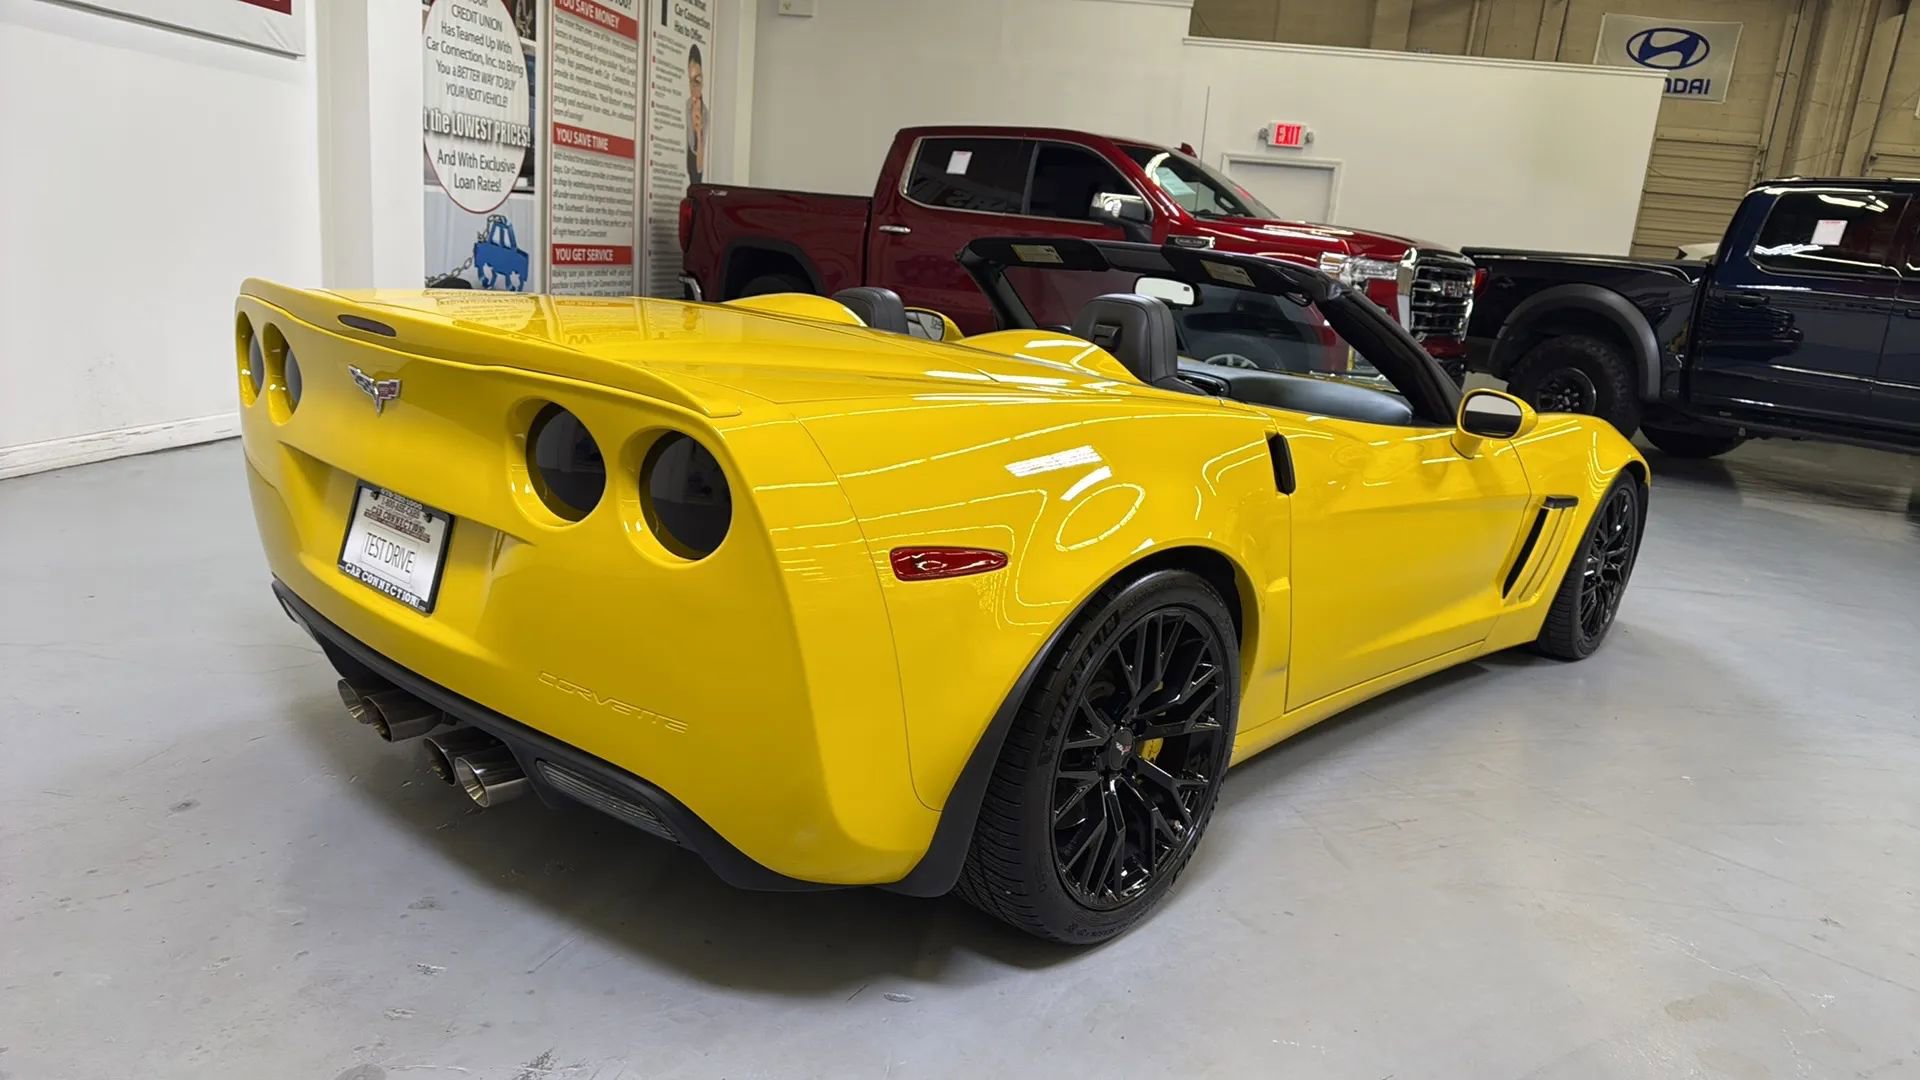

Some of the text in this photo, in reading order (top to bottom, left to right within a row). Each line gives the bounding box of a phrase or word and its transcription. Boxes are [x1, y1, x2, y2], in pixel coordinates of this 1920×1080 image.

[452, 4, 502, 32] CREDIT UNION
[576, 0, 594, 19] SAVE
[595, 6, 620, 29] MONEY
[674, 3, 684, 17] Car
[684, 7, 711, 31] Connection
[441, 20, 512, 55] Has Teamed Up With
[426, 36, 440, 51] Car
[441, 40, 484, 66] Connection,
[498, 57, 506, 71] to
[507, 60, 524, 79] Bring
[436, 59, 451, 75] You
[457, 65, 480, 82] BETTER
[481, 72, 495, 86] WAY
[495, 75, 504, 89] TO
[504, 77, 516, 91] BUY
[446, 81, 464, 98] YOUR
[466, 86, 482, 101] NEXT
[430, 108, 450, 135] the
[452, 112, 493, 141] LOWEST
[494, 119, 531, 148] PRICES!
[556, 127, 609, 151] YOU SAVE TIME
[1275, 124, 1302, 145] EXIT
[437, 148, 516, 174] And With Exclusive
[454, 173, 502, 193] Loan Rates!
[555, 247, 614, 262] YOU GET SERVICE
[364, 532, 386, 561] TEST
[385, 541, 416, 574] DRIVE
[344, 563, 361, 579] CAR
[538, 670, 689, 734] CORVETTE
